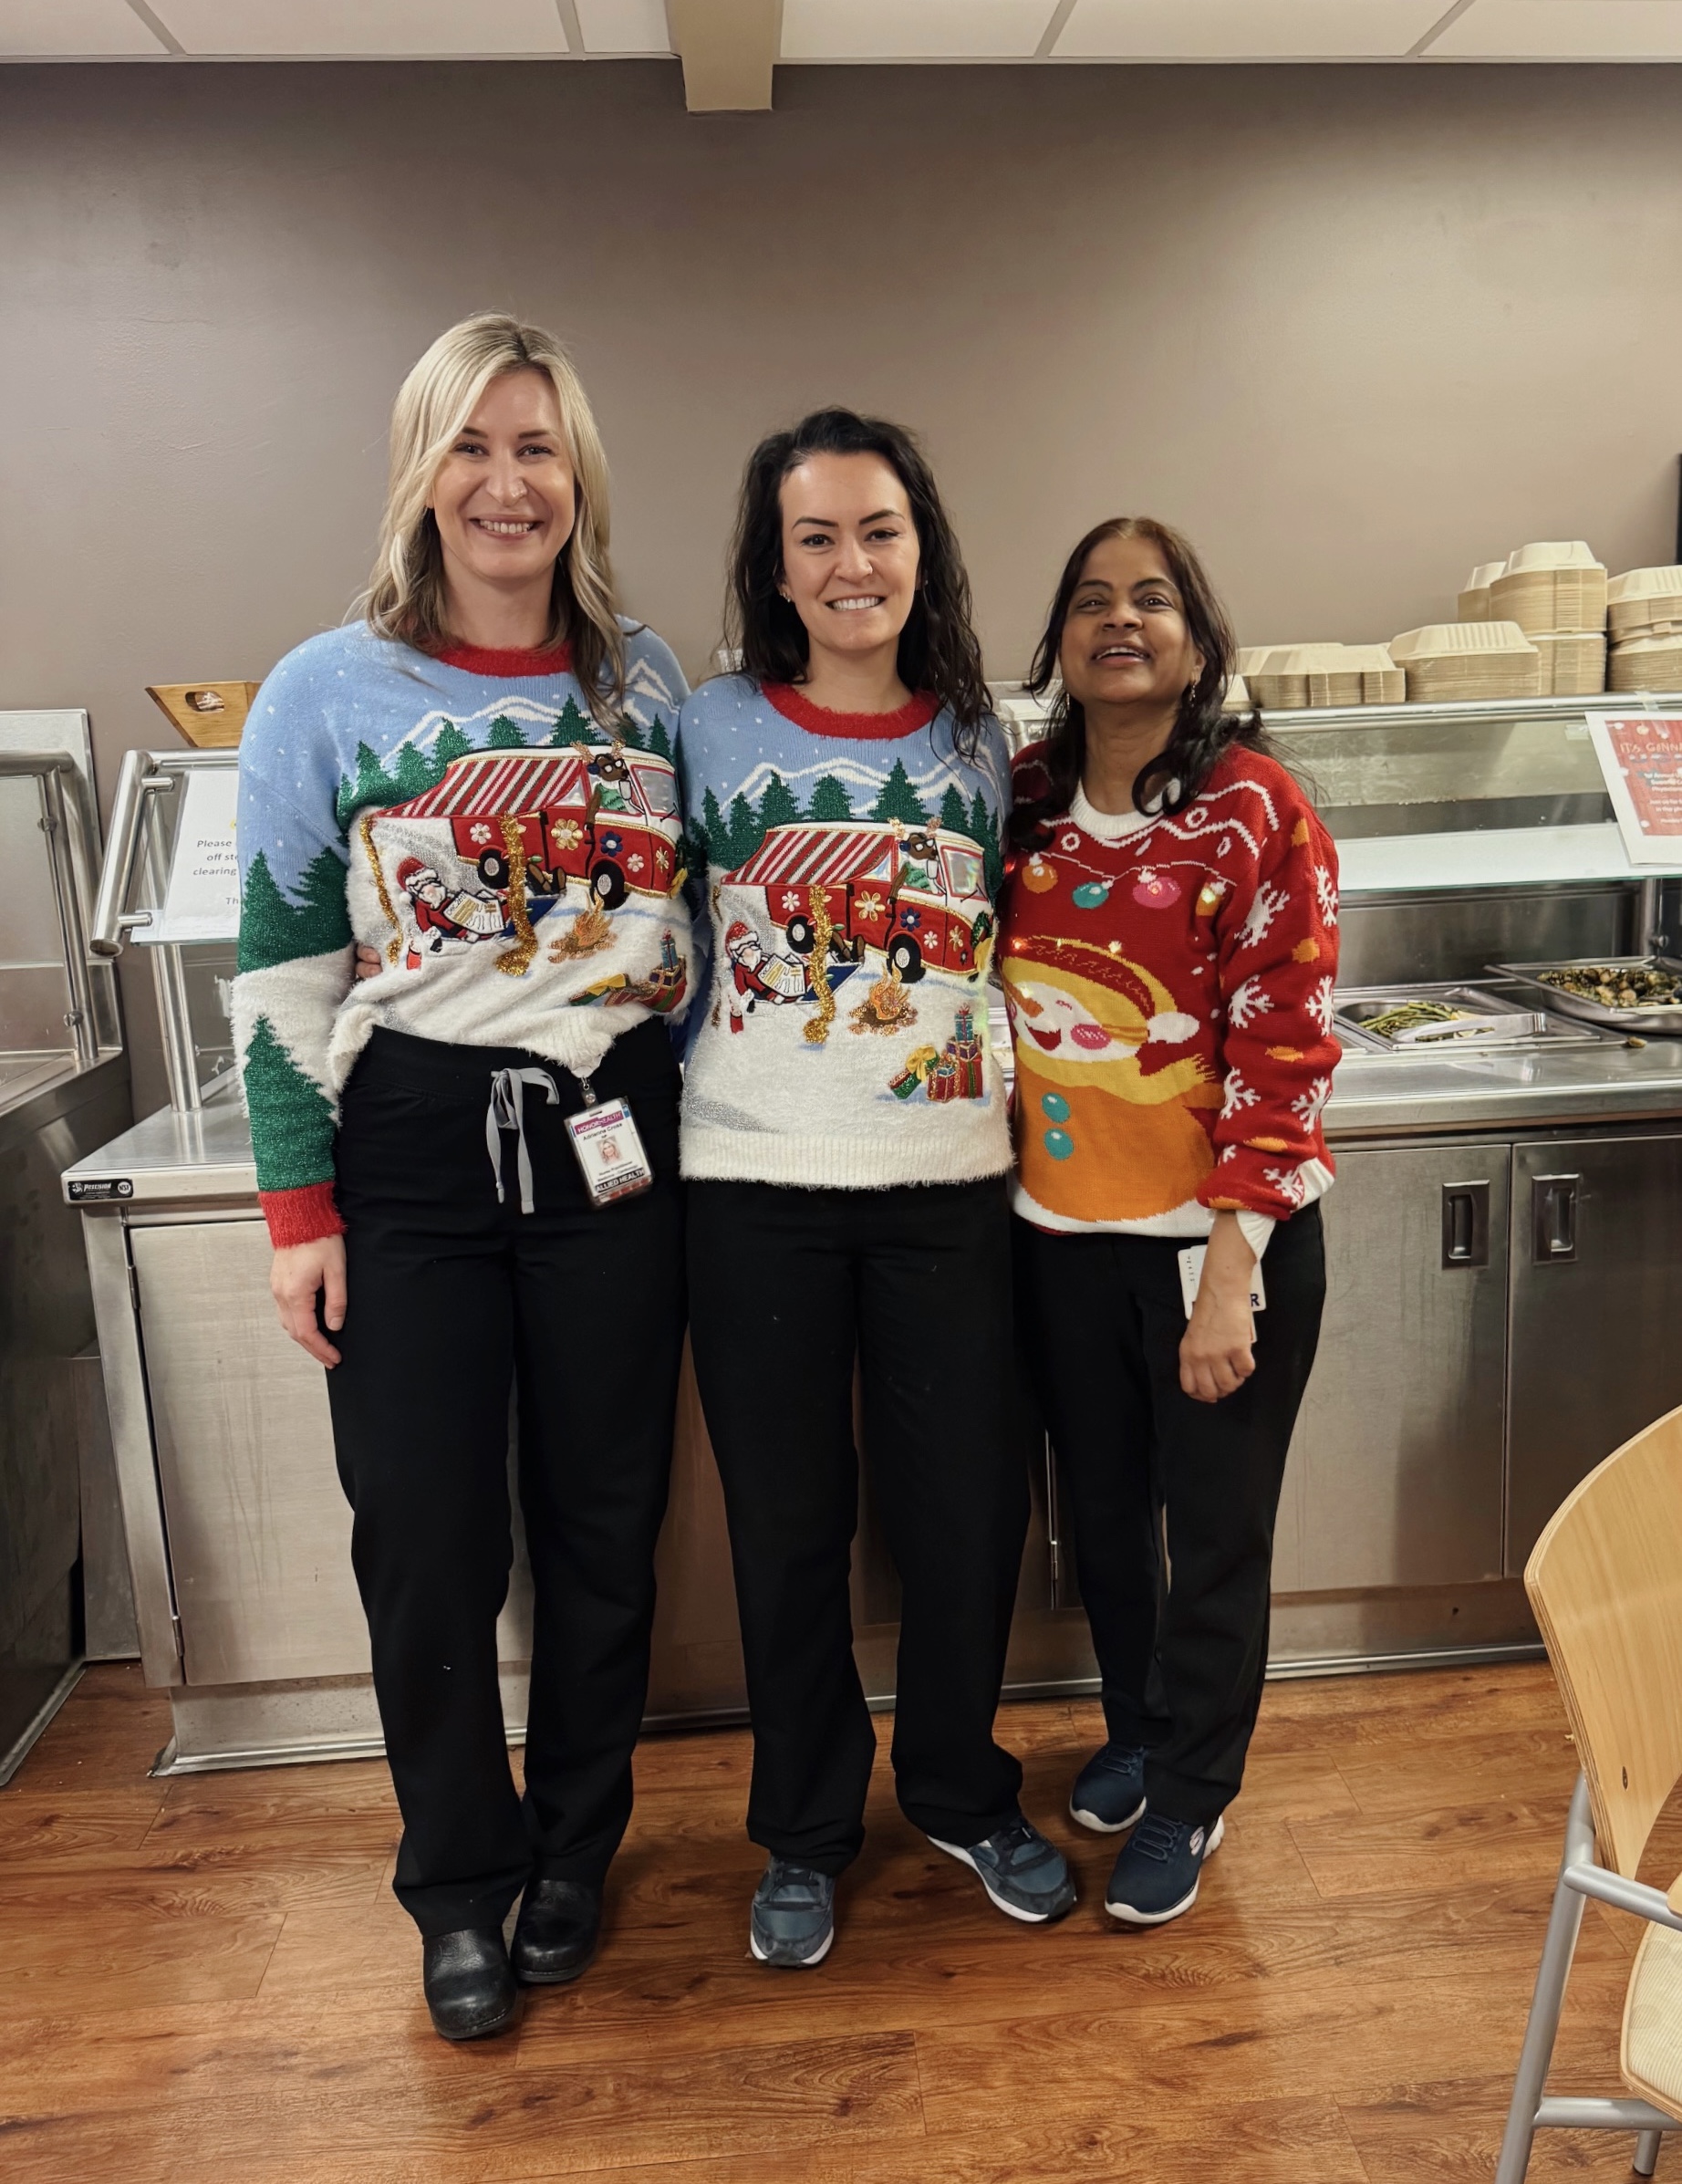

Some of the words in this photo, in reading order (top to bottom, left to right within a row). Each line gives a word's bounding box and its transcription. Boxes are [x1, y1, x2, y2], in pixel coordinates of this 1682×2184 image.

[196, 839, 233, 848] Please
[206, 853, 223, 861] off
[192, 868, 237, 876] clearing
[618, 1169, 645, 1184] HEALTH
